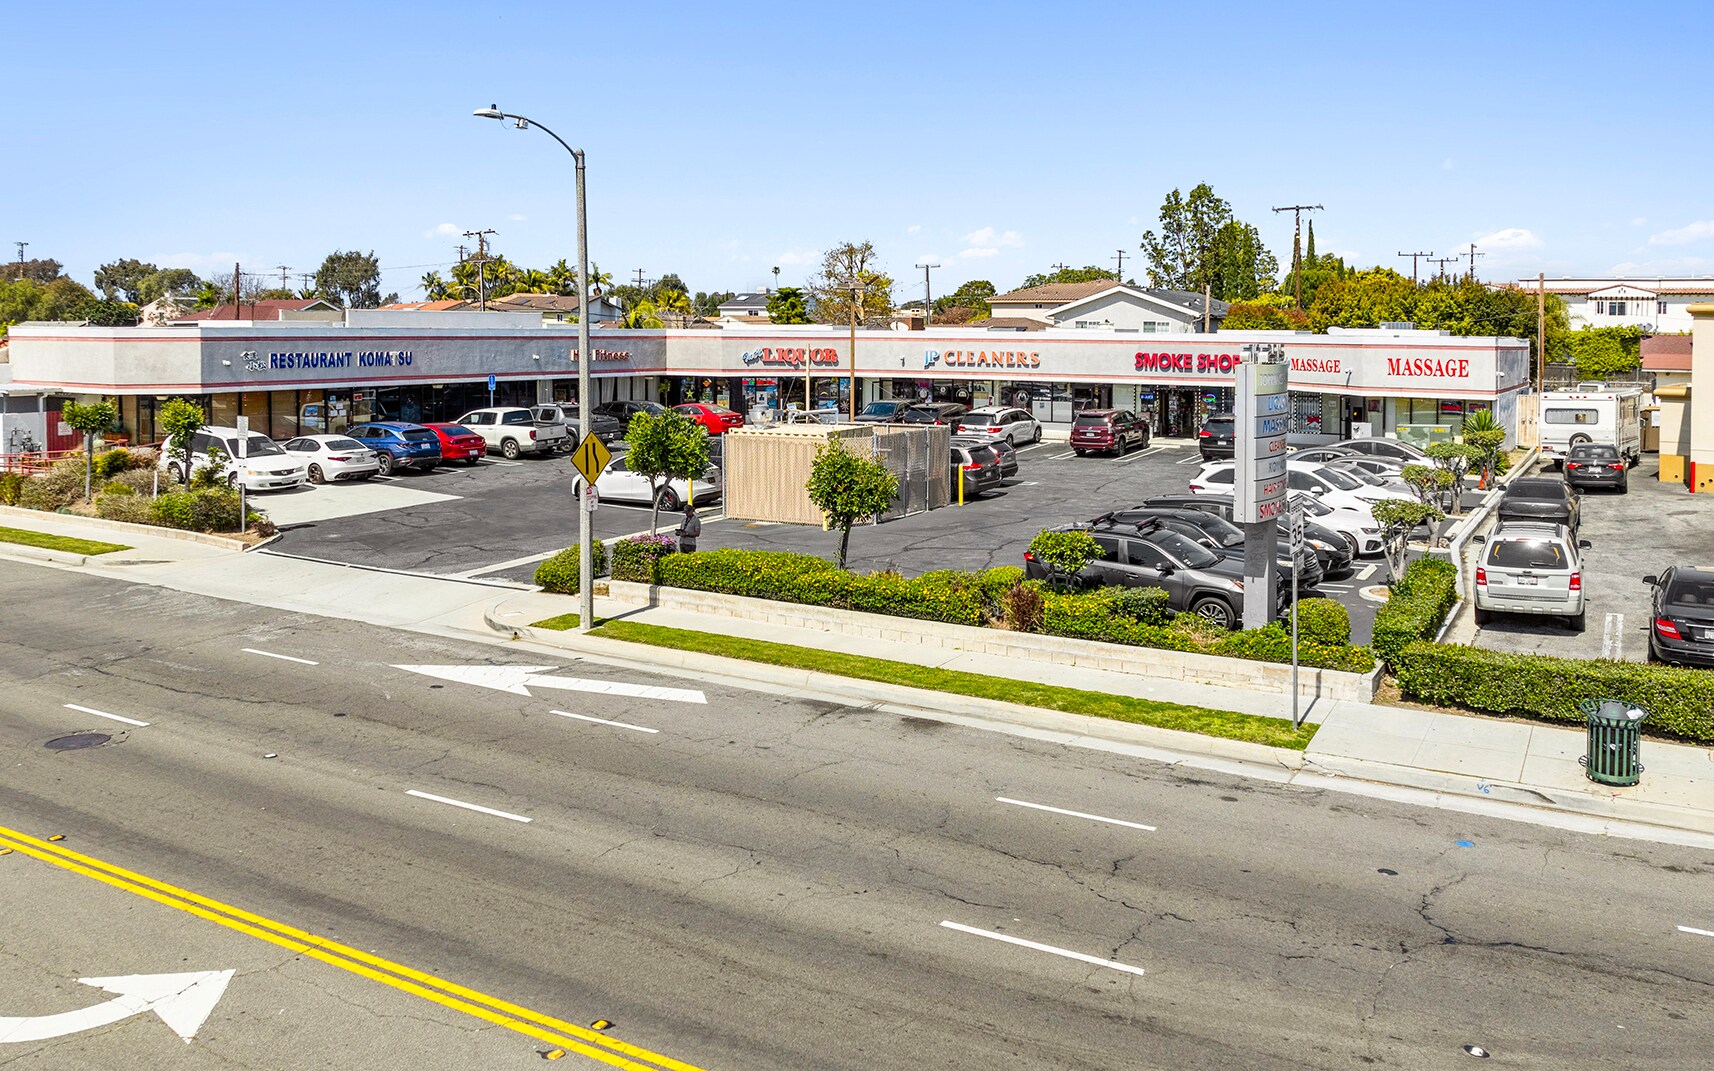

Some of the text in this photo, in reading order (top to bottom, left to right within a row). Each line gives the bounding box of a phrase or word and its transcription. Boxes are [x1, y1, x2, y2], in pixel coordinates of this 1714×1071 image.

[269, 351, 351, 369] RESTAURANT
[358, 351, 412, 367] KOMATSU
[592, 349, 630, 361] Fitness
[762, 347, 839, 367] LIQUOR
[924, 350, 1040, 367] JP CLEANERS
[1134, 352, 1193, 371] SMOKE
[1290, 358, 1341, 374] MASSAGE
[1387, 358, 1469, 378] MASSAGE
[1267, 395, 1288, 410] LIQU
[1262, 417, 1288, 434] MASS
[1291, 524, 1303, 547] 35
